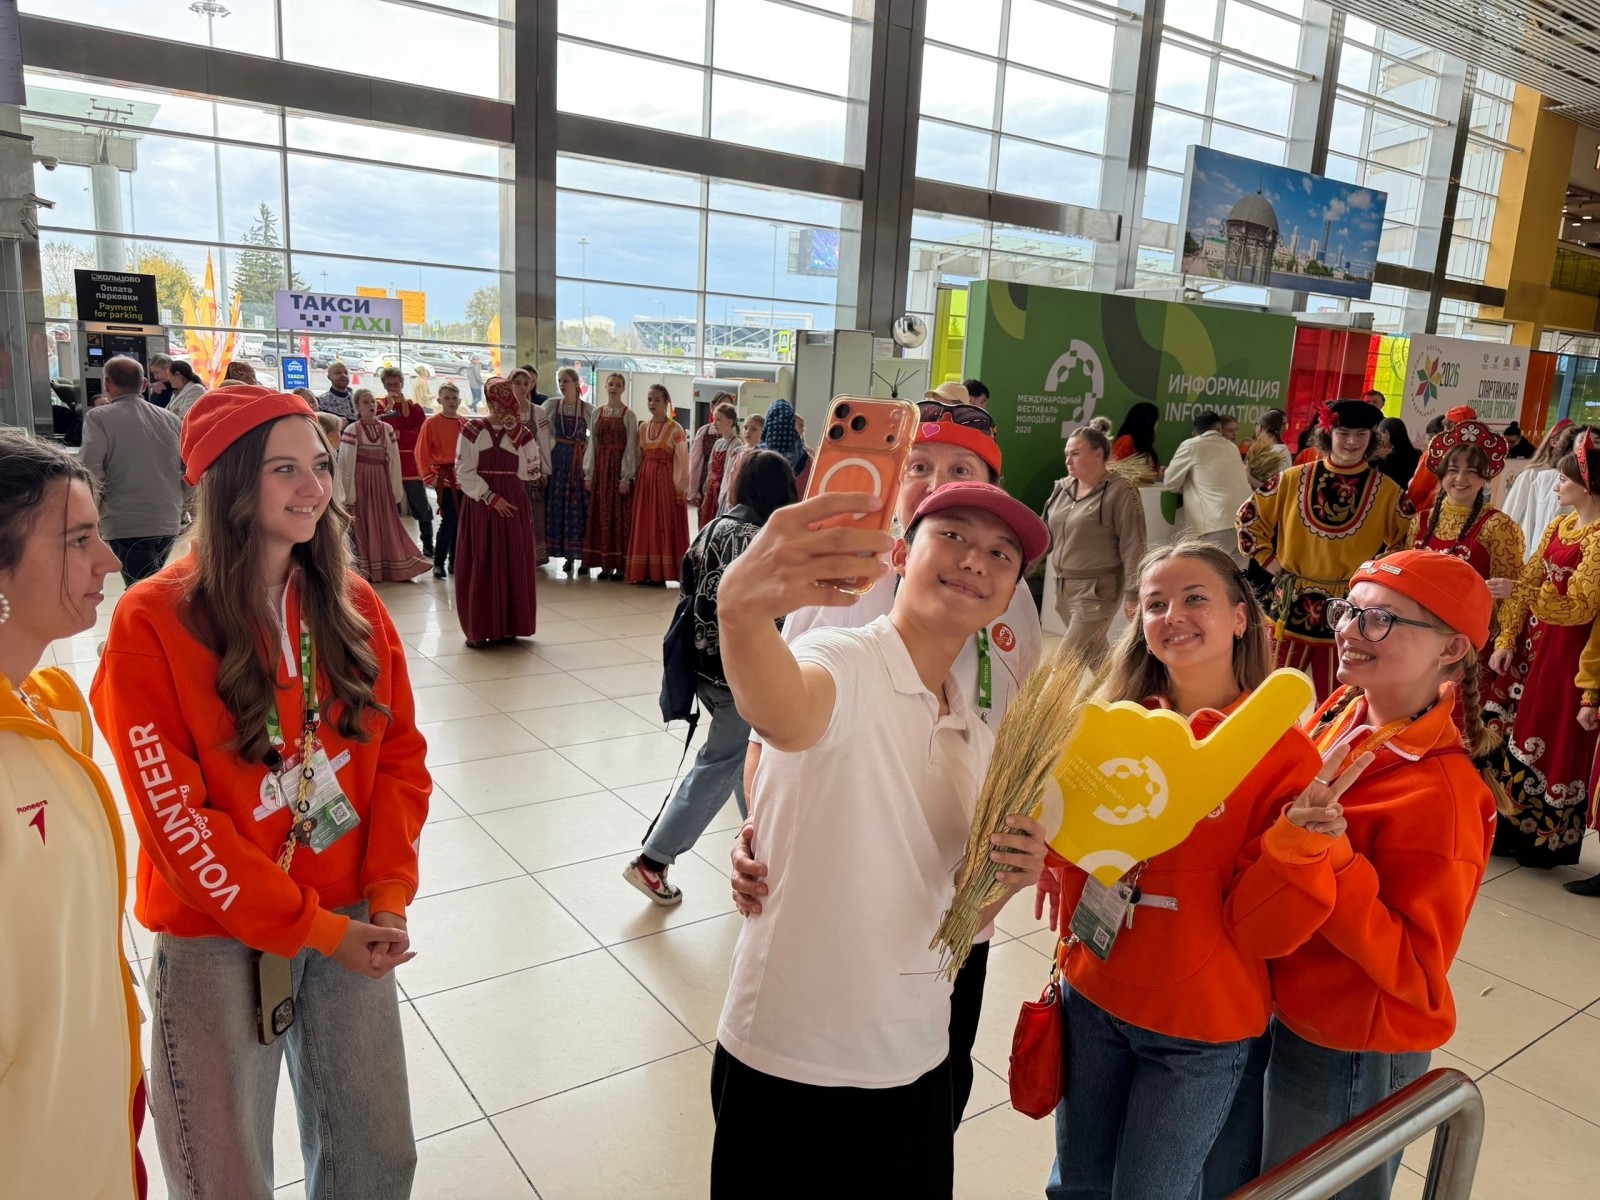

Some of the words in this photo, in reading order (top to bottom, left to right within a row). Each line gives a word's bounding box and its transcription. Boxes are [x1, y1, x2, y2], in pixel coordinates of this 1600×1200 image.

[97, 274, 141, 283] КОЛЬЦОВО
[100, 284, 133, 293] Оплата
[95, 292, 139, 302] парковки
[98, 302, 138, 312] Payment
[289, 294, 370, 314] ТАКСИ
[94, 309, 107, 318] for
[109, 312, 143, 321] parking
[339, 315, 391, 332] TAXI
[1439, 362, 1460, 388] 2026
[1168, 374, 1281, 402] ИНФОРМАЦИЯ
[1017, 394, 1082, 405] МЕЖДУНАРОДНЫЙ
[1016, 405, 1058, 413] ФЕСТИВАЛЬ
[1015, 414, 1056, 424] МОЛОДЁЖИ
[1015, 425, 1032, 434] 2026
[16, 799, 48, 814] Pioneers
[128, 721, 241, 912] VOLUNTEER
